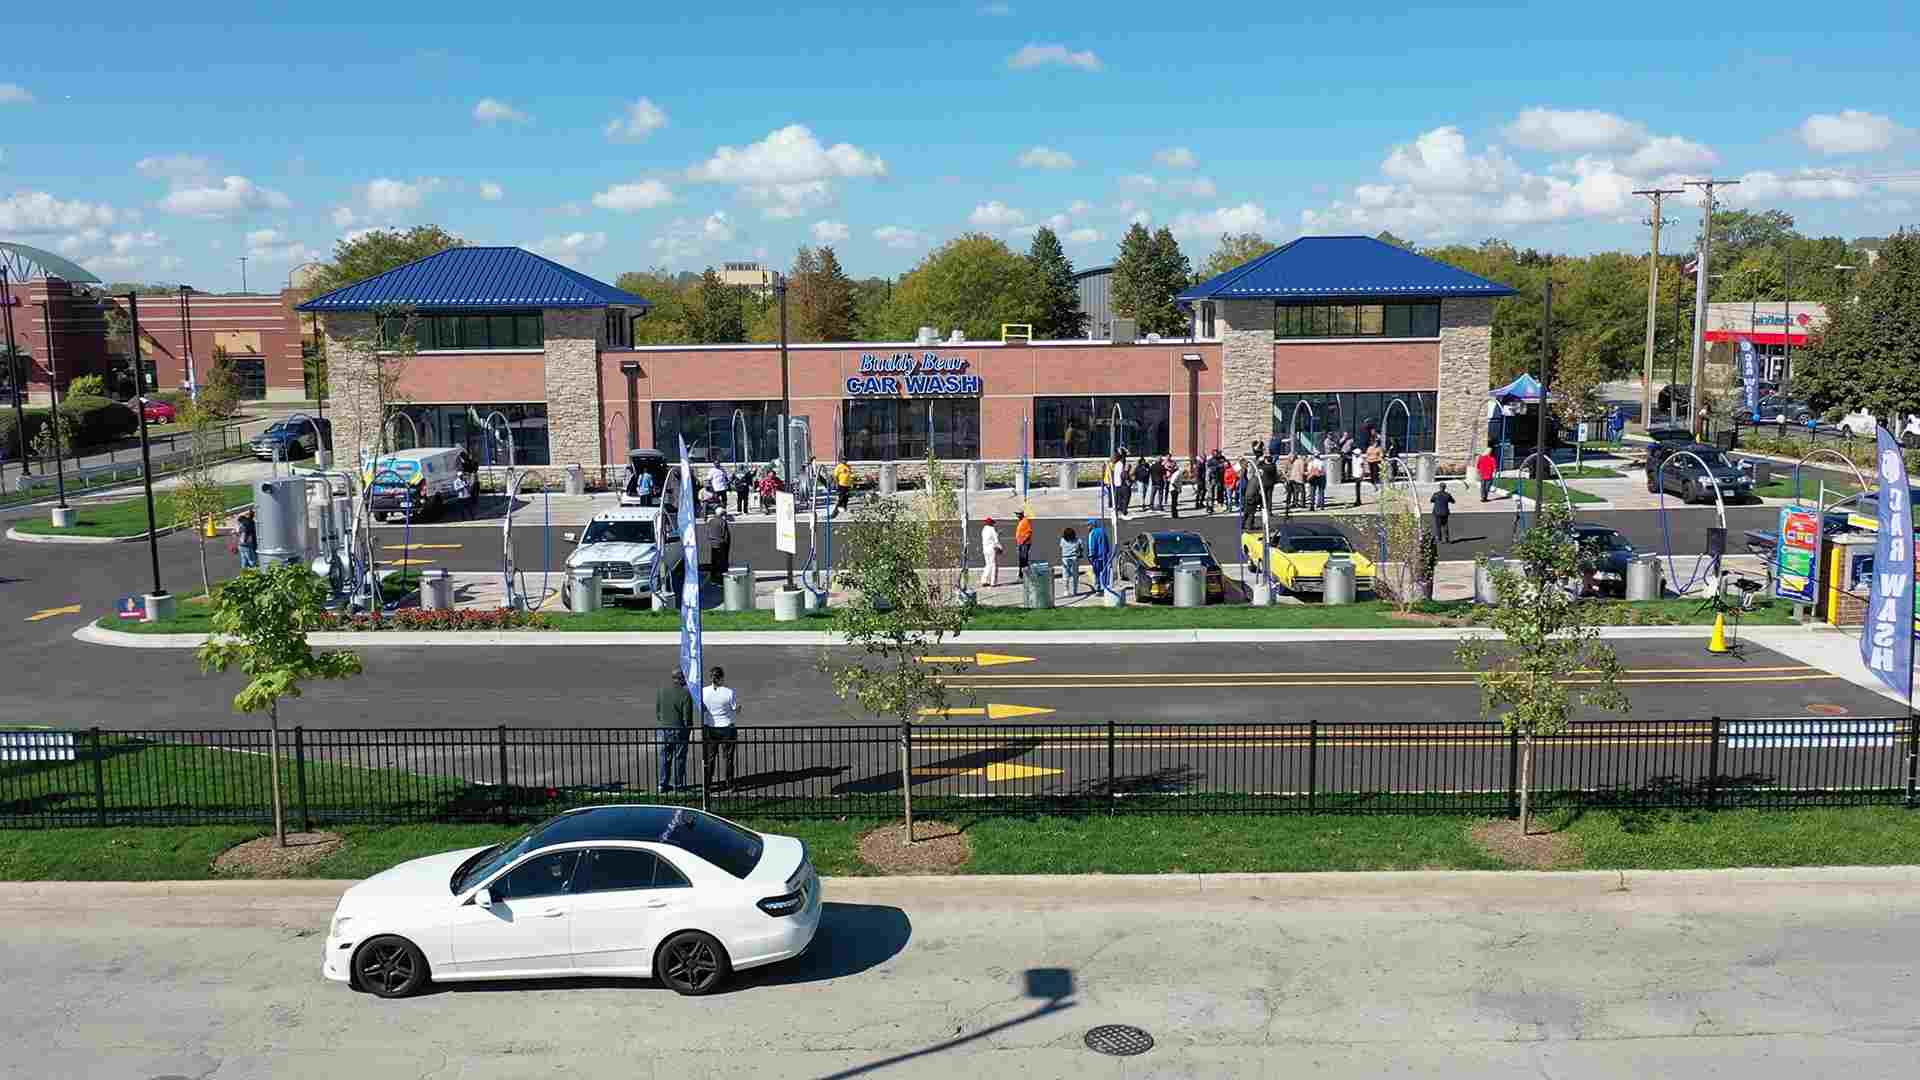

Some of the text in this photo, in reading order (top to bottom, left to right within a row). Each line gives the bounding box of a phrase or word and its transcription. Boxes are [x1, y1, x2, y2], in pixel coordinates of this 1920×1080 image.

[860, 352, 965, 375] Buddy Bear
[847, 375, 980, 394] CAR WASH
